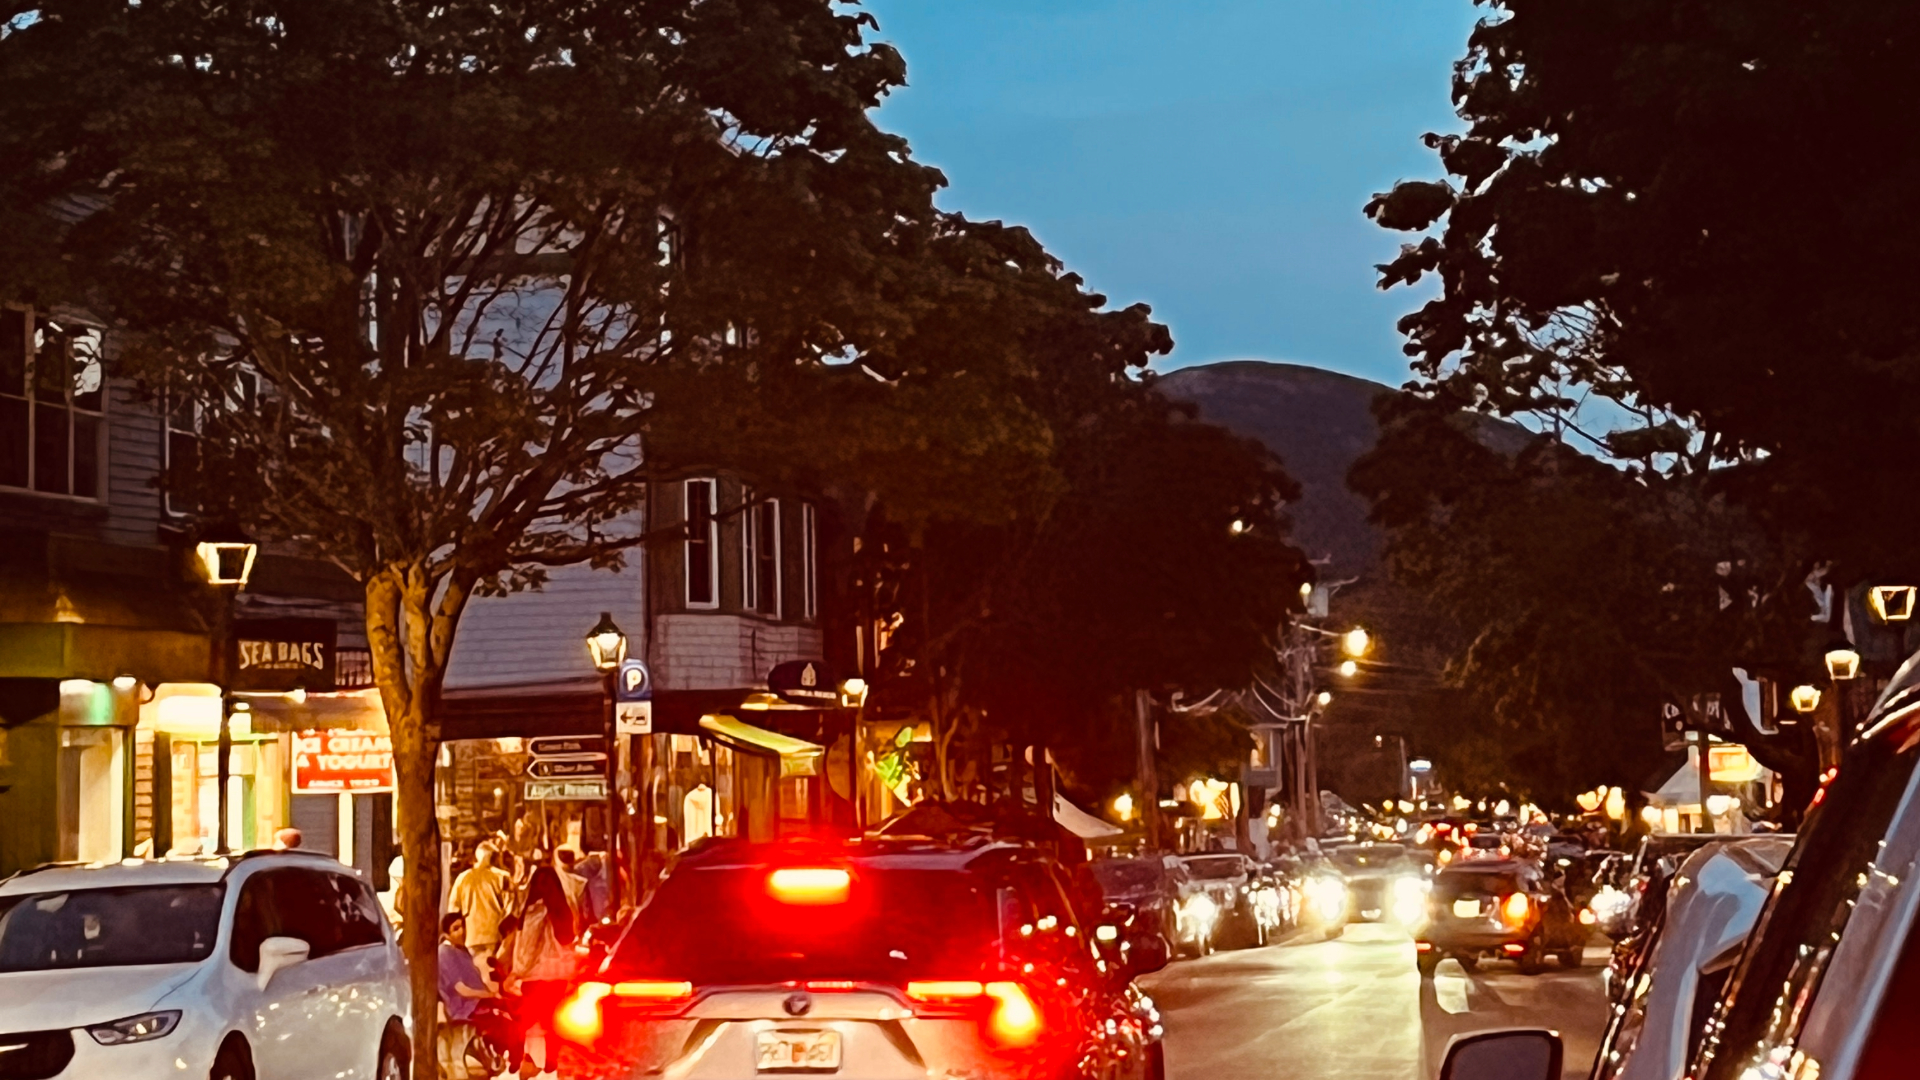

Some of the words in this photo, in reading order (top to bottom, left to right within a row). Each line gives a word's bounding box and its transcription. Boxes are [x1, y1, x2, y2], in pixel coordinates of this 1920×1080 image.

[238, 640, 273, 669] SEA
[278, 642, 324, 670] BAGS
[626, 669, 642, 692] P
[316, 752, 392, 771] YOGURT
